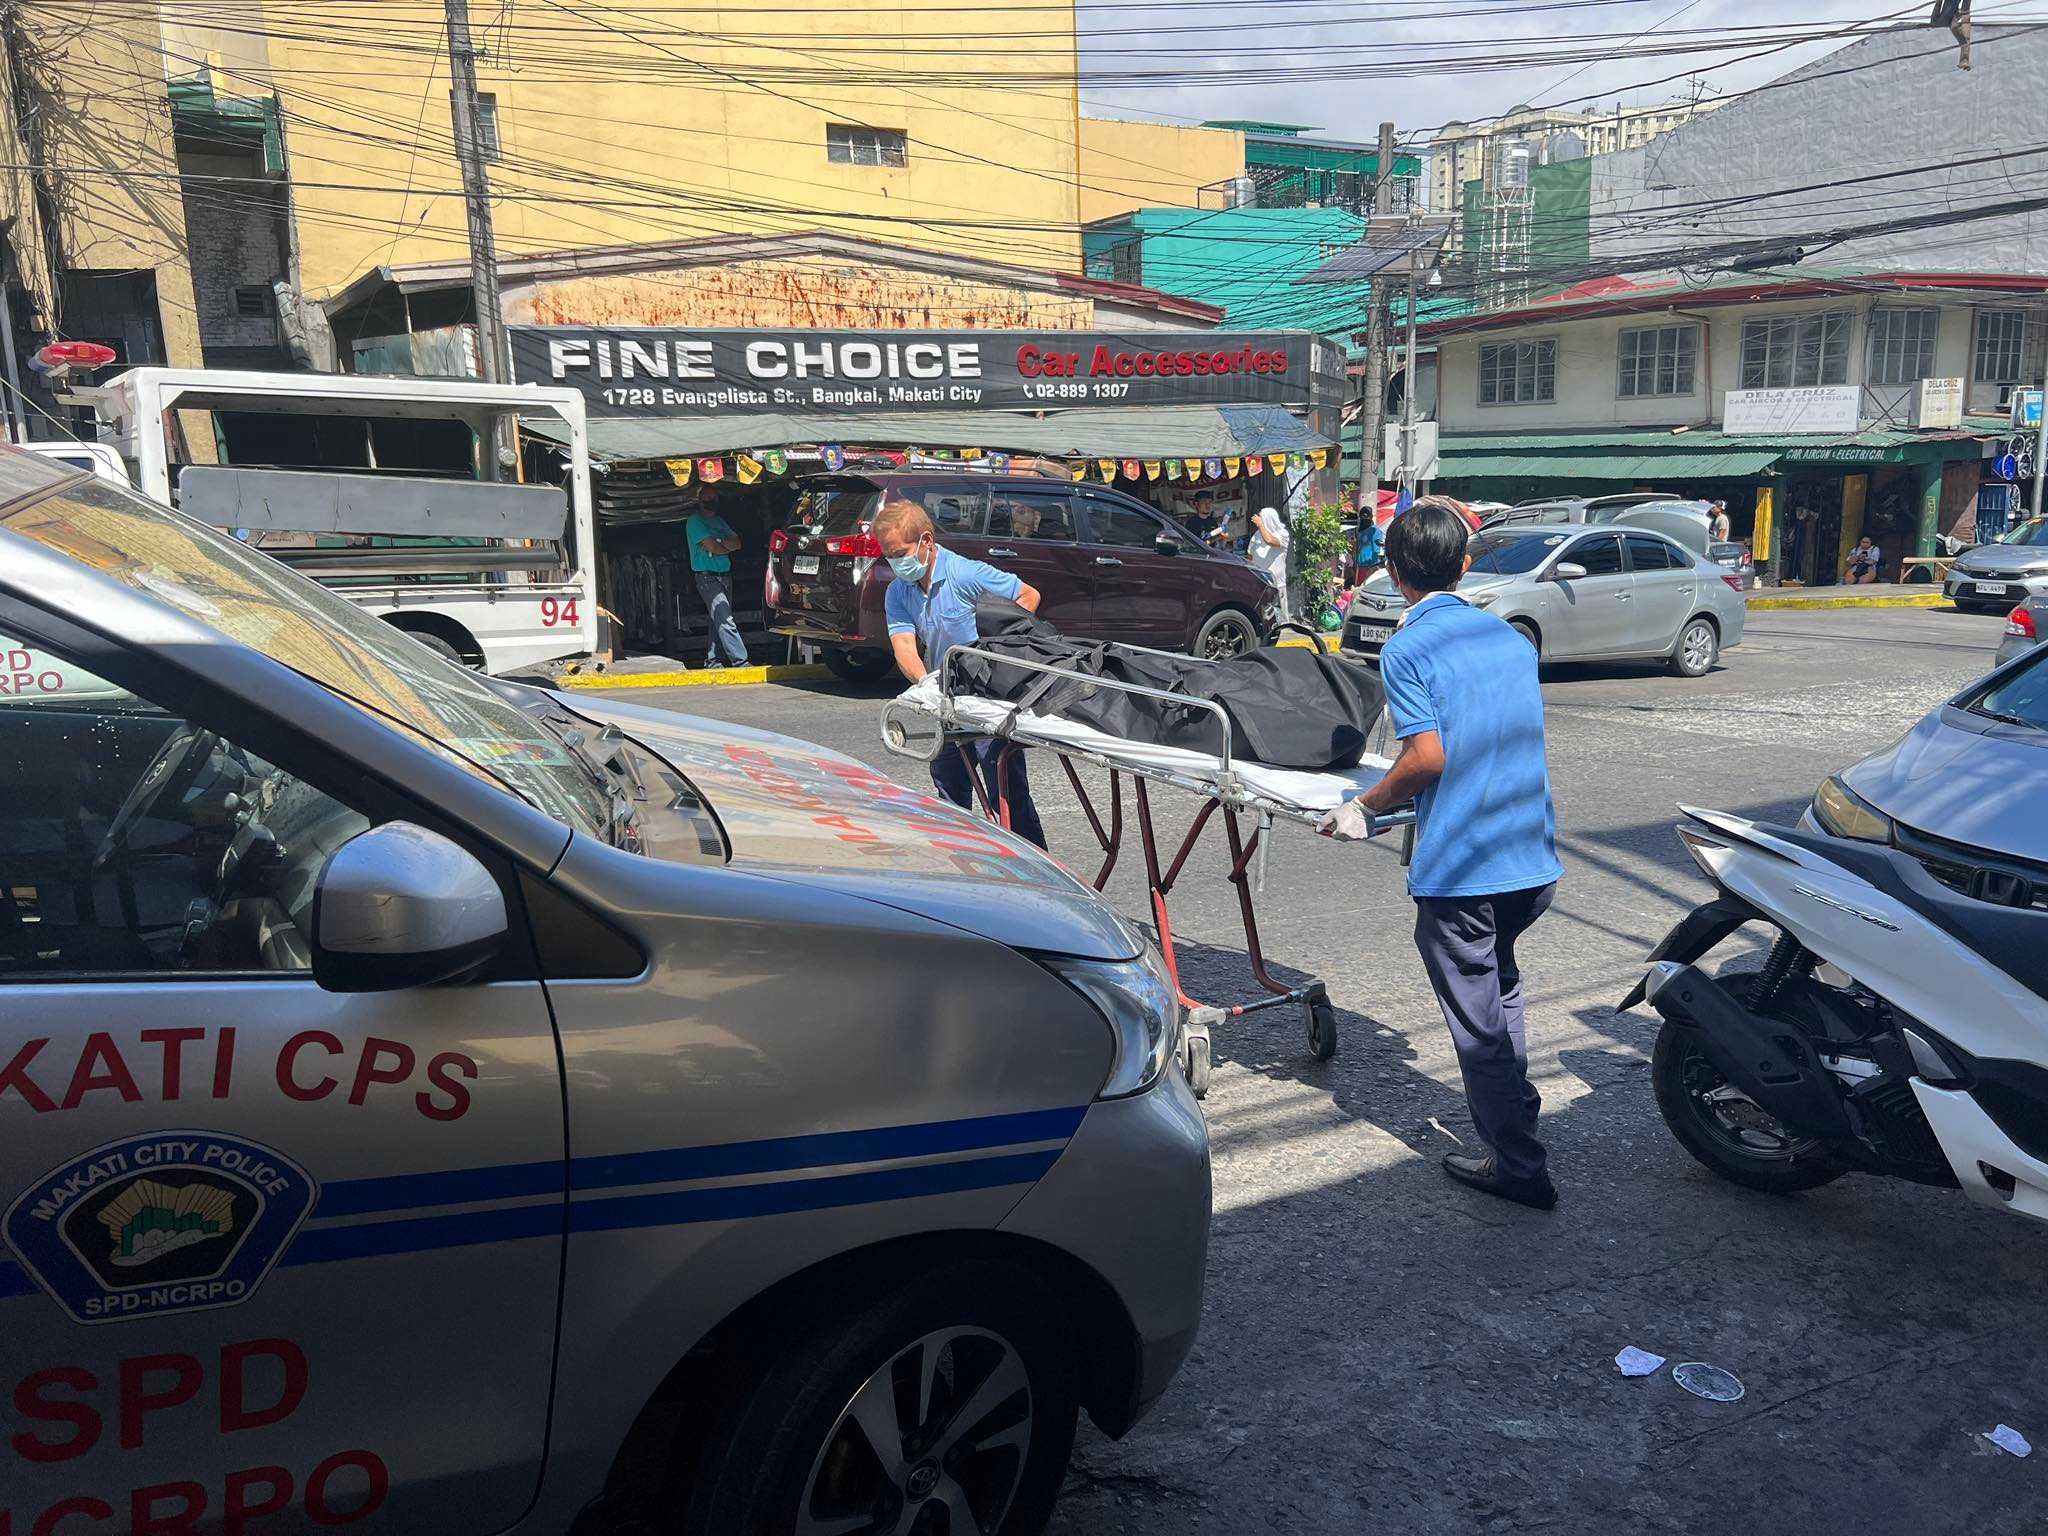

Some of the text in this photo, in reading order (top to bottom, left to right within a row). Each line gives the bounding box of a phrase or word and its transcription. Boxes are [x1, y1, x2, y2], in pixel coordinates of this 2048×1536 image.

[550, 340, 982, 379] FINE CHOICE
[1017, 343, 1081, 378] Car
[1088, 343, 1289, 377] Accessories
[602, 388, 656, 405] 1728
[662, 387, 768, 408] Evangelista
[812, 386, 883, 406] Bangkai,
[888, 385, 945, 402] Makati
[950, 386, 982, 404] City
[1036, 382, 1129, 399] 02-889 1307
[1745, 388, 1837, 399] DELA CRUZ
[1785, 449, 1803, 460] CAR
[1804, 449, 1831, 460] AIRCON
[1836, 449, 1885, 460] ELECTRICAL
[541, 596, 580, 627] 94
[275, 1030, 478, 1121] CPS
[31, 1142, 290, 1221] MAKATI CITY POLICE
[85, 1279, 246, 1316] SPD-NCRPO
[10, 1338, 309, 1463] SPD
